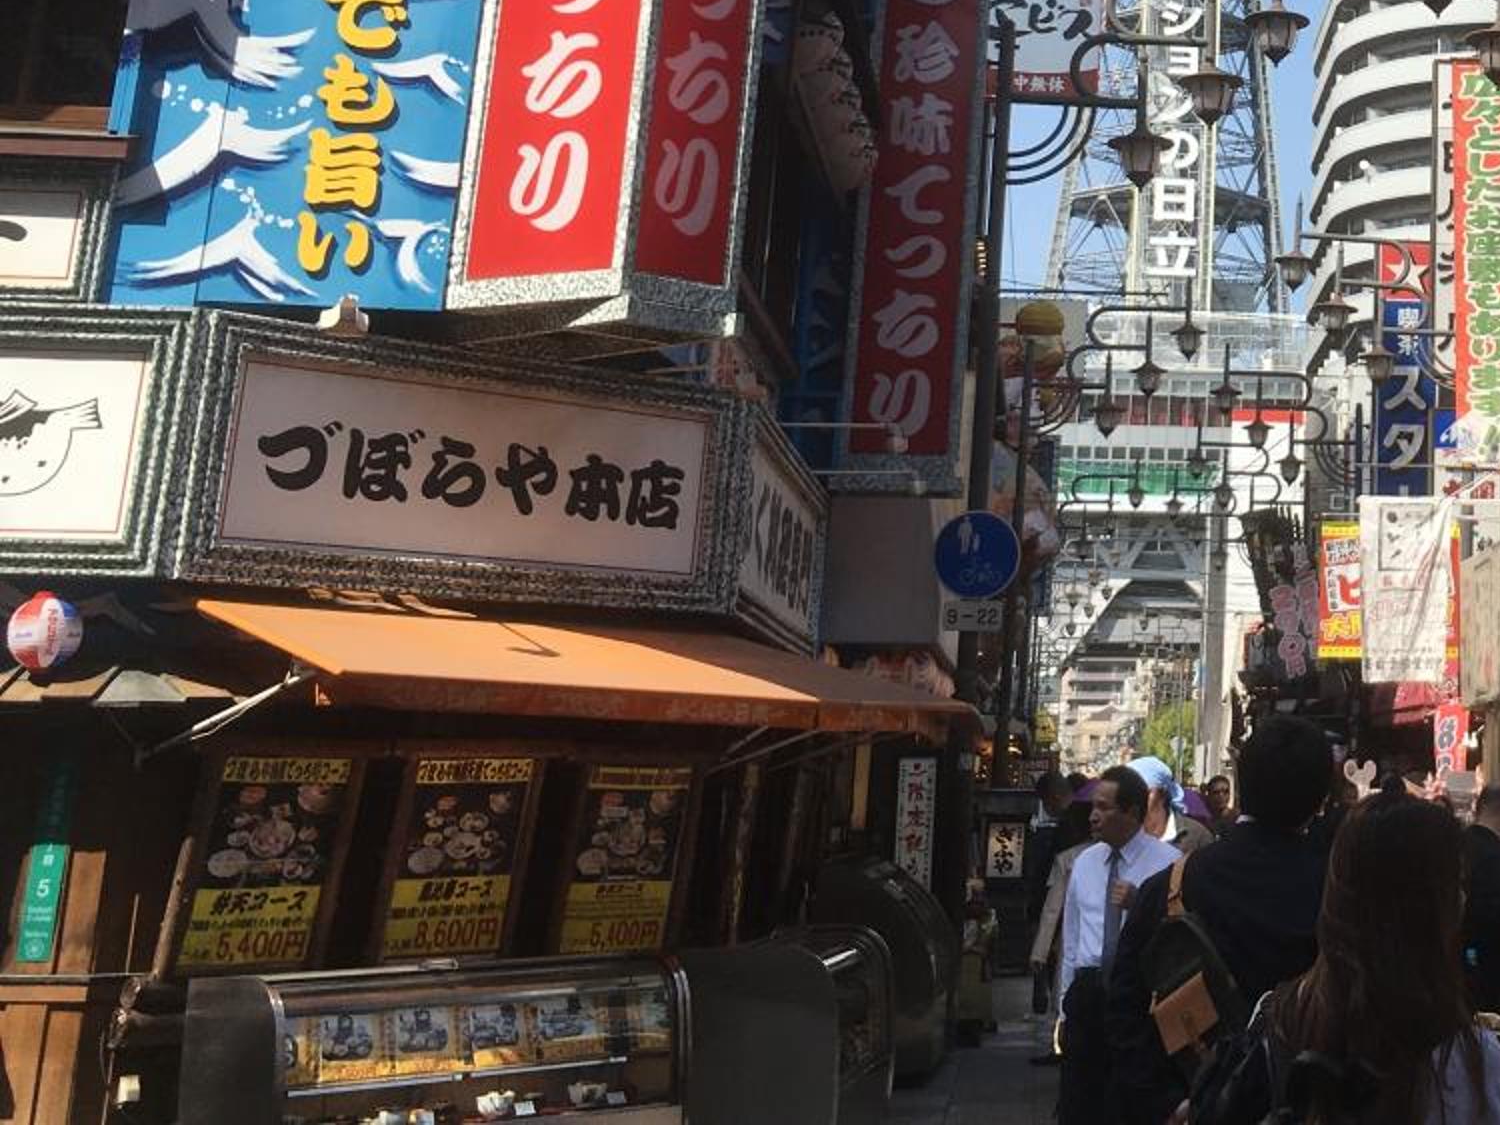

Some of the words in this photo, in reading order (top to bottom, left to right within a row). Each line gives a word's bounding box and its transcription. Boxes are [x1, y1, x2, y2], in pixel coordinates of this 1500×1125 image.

[256, 418, 685, 531] づぼらや本店
[36, 878, 50, 898] 5
[416, 917, 497, 950] 8,600円
